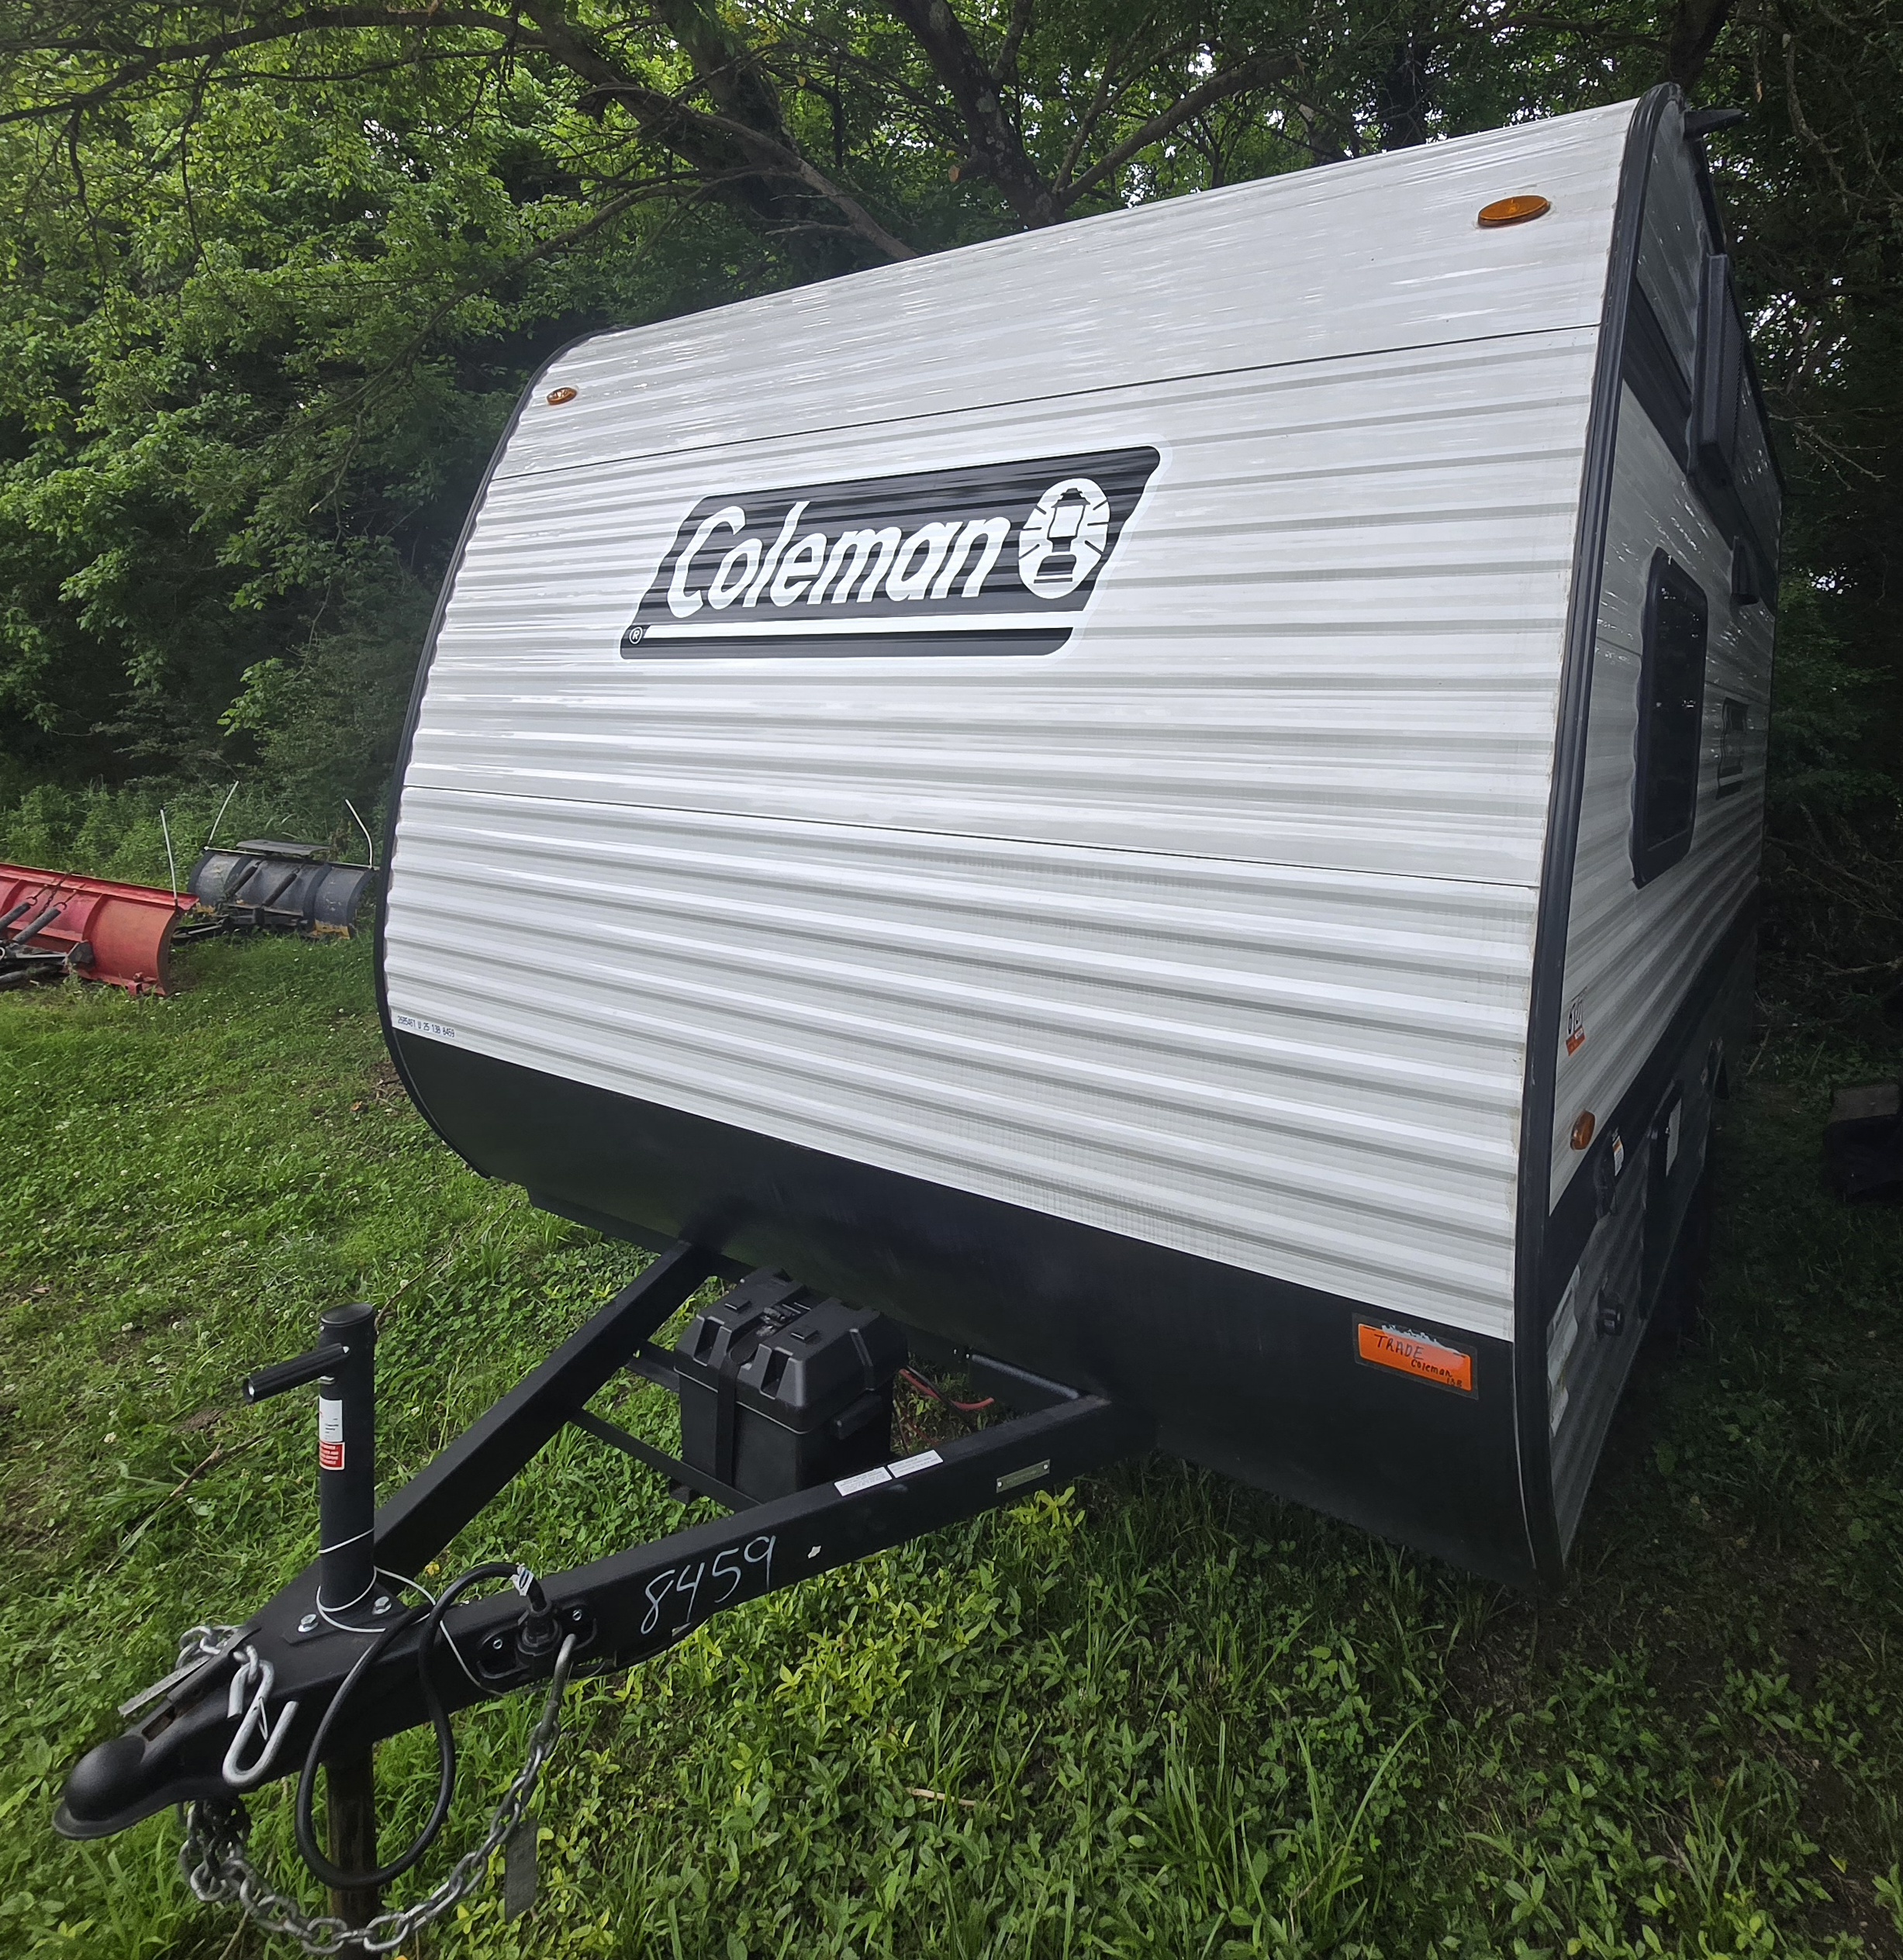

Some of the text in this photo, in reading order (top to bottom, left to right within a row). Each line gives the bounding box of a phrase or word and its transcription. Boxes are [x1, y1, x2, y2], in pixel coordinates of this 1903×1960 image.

[666, 501, 1011, 619] Coleman
[423, 1022, 430, 1031] 25
[1374, 1334, 1425, 1359] TRADE
[1411, 1358, 1453, 1378] Coleman
[640, 1535, 776, 1635] 8459
